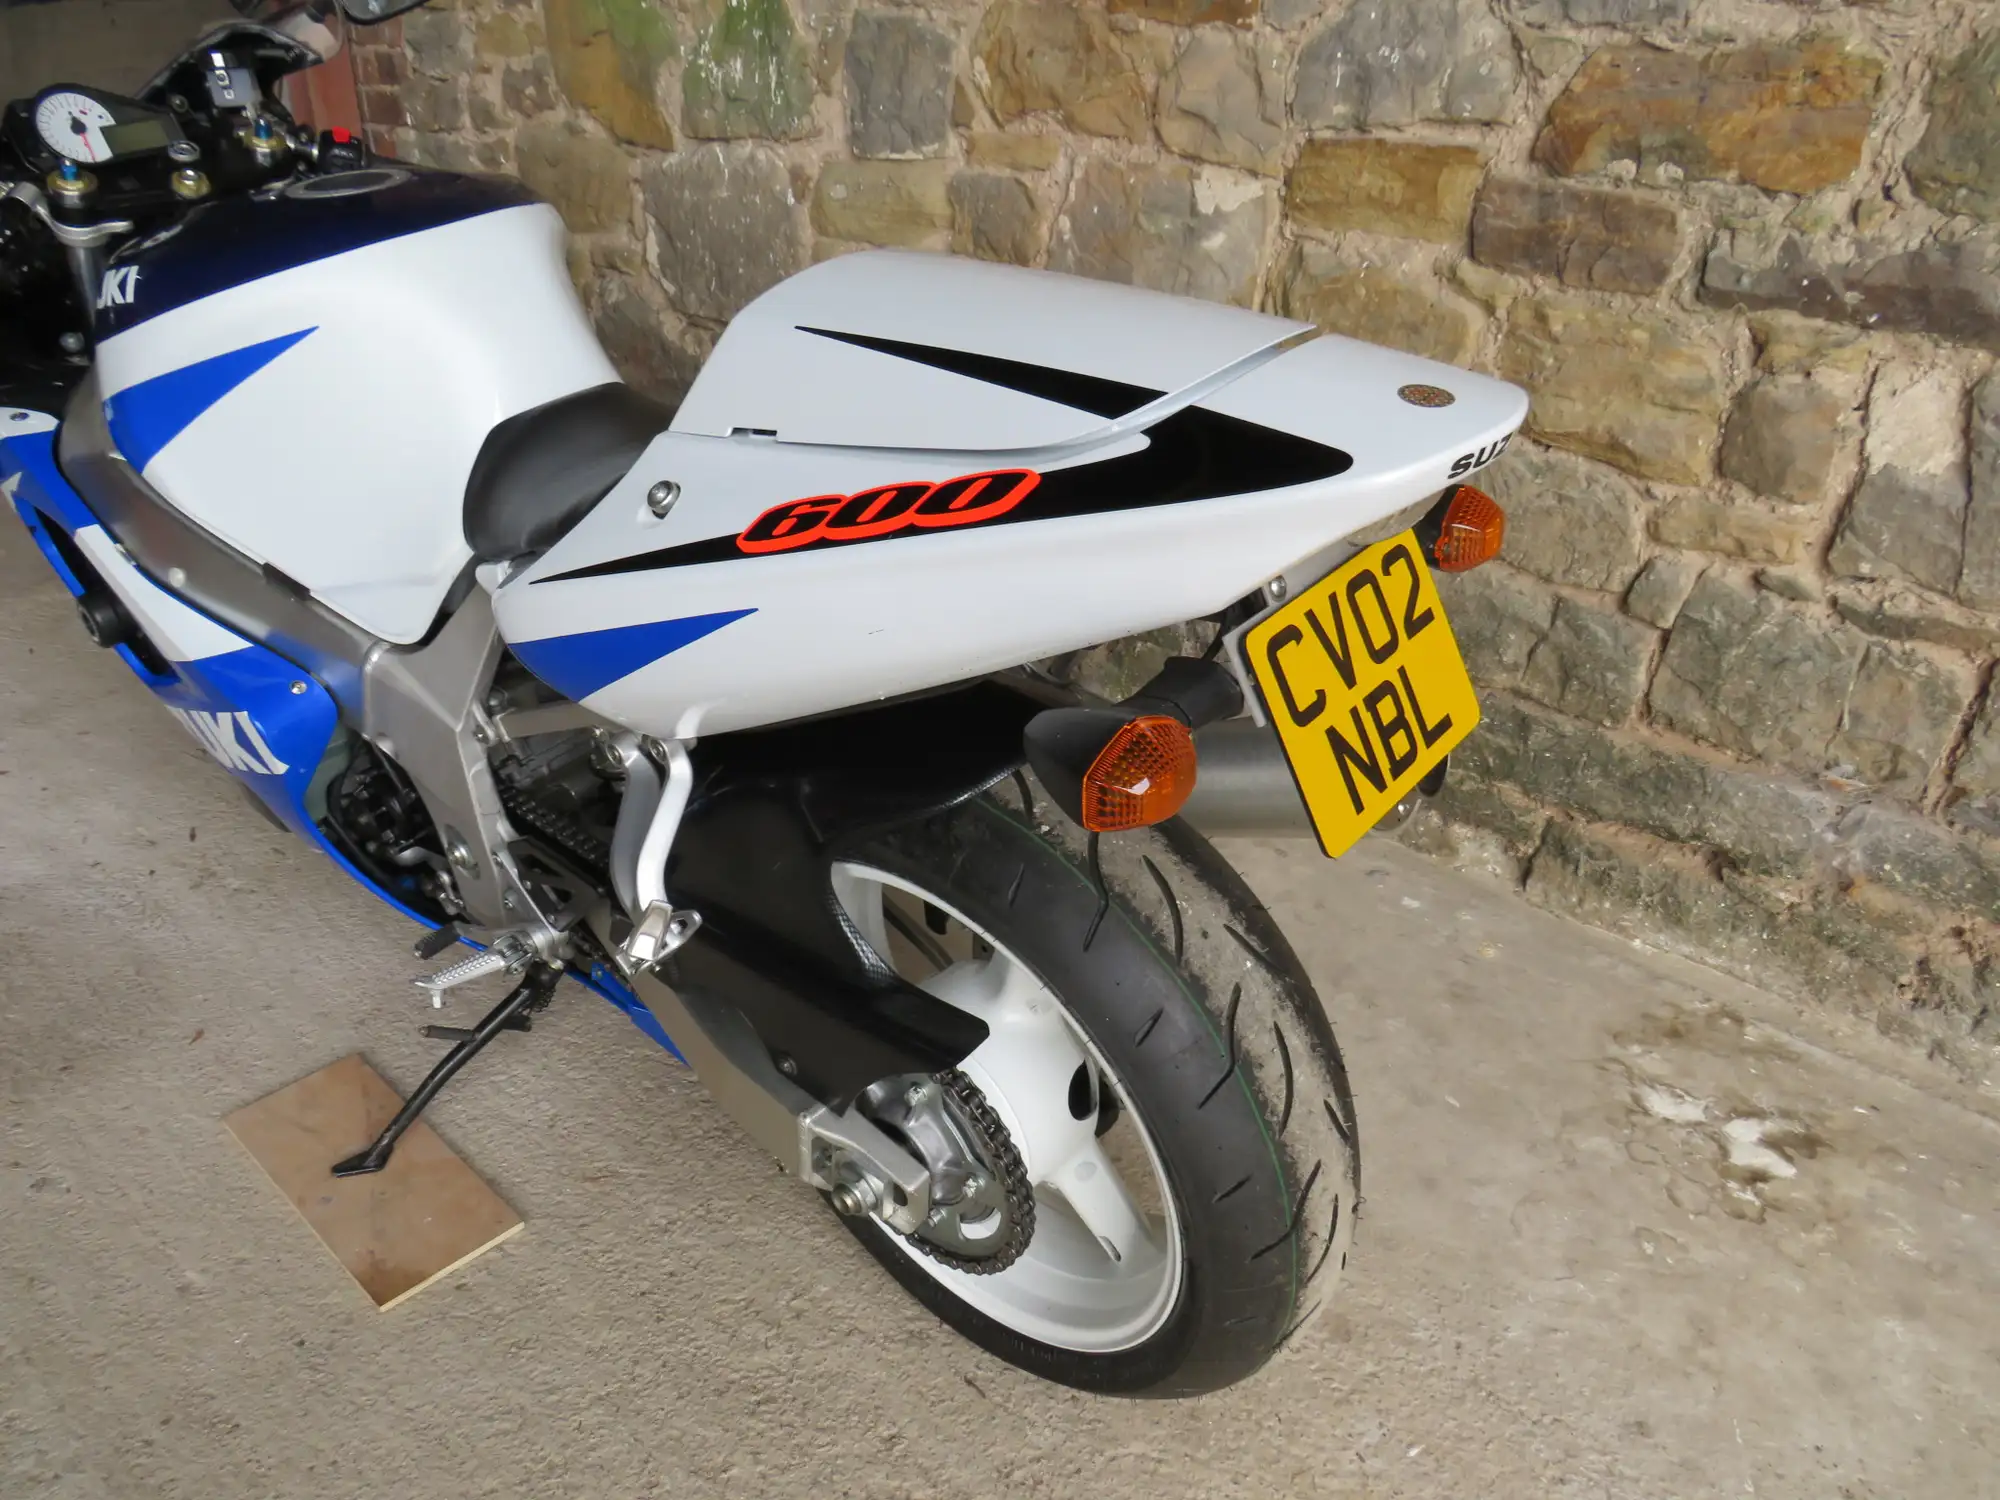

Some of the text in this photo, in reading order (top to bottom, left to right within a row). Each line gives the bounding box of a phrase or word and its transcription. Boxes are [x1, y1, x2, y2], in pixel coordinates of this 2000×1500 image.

[736, 468, 1041, 553] 600
[1266, 543, 1435, 728] CV02
[1324, 665, 1453, 816] NBL
